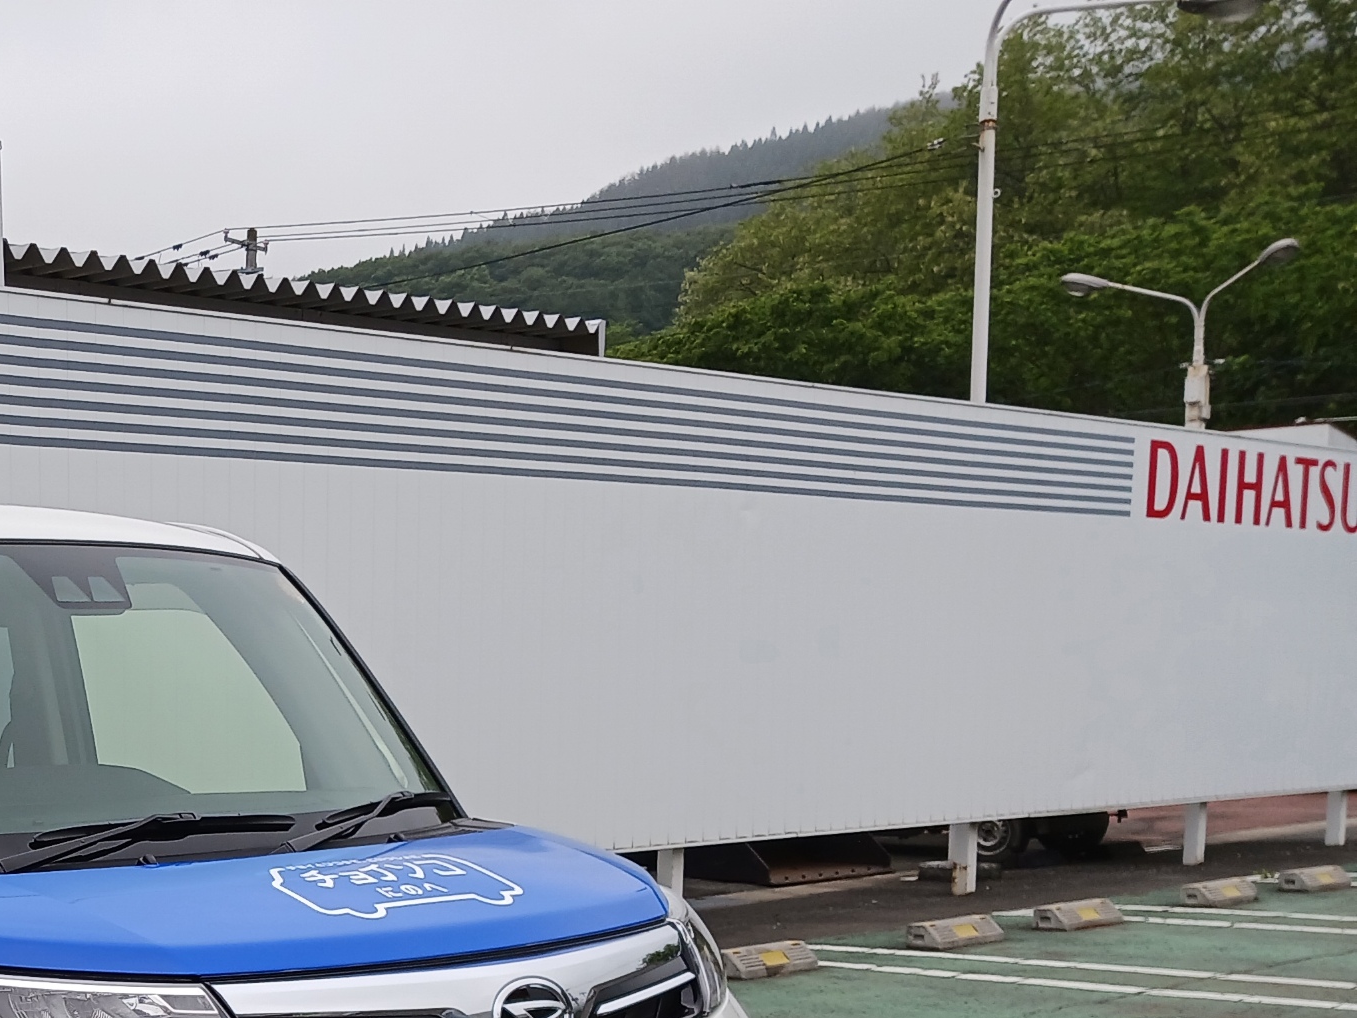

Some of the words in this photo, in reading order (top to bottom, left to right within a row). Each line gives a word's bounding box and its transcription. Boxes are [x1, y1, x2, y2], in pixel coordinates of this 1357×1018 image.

[1146, 439, 1357, 533] DAIHATSU
[300, 860, 467, 888] チョイソコ
[376, 882, 448, 898] にのへ
